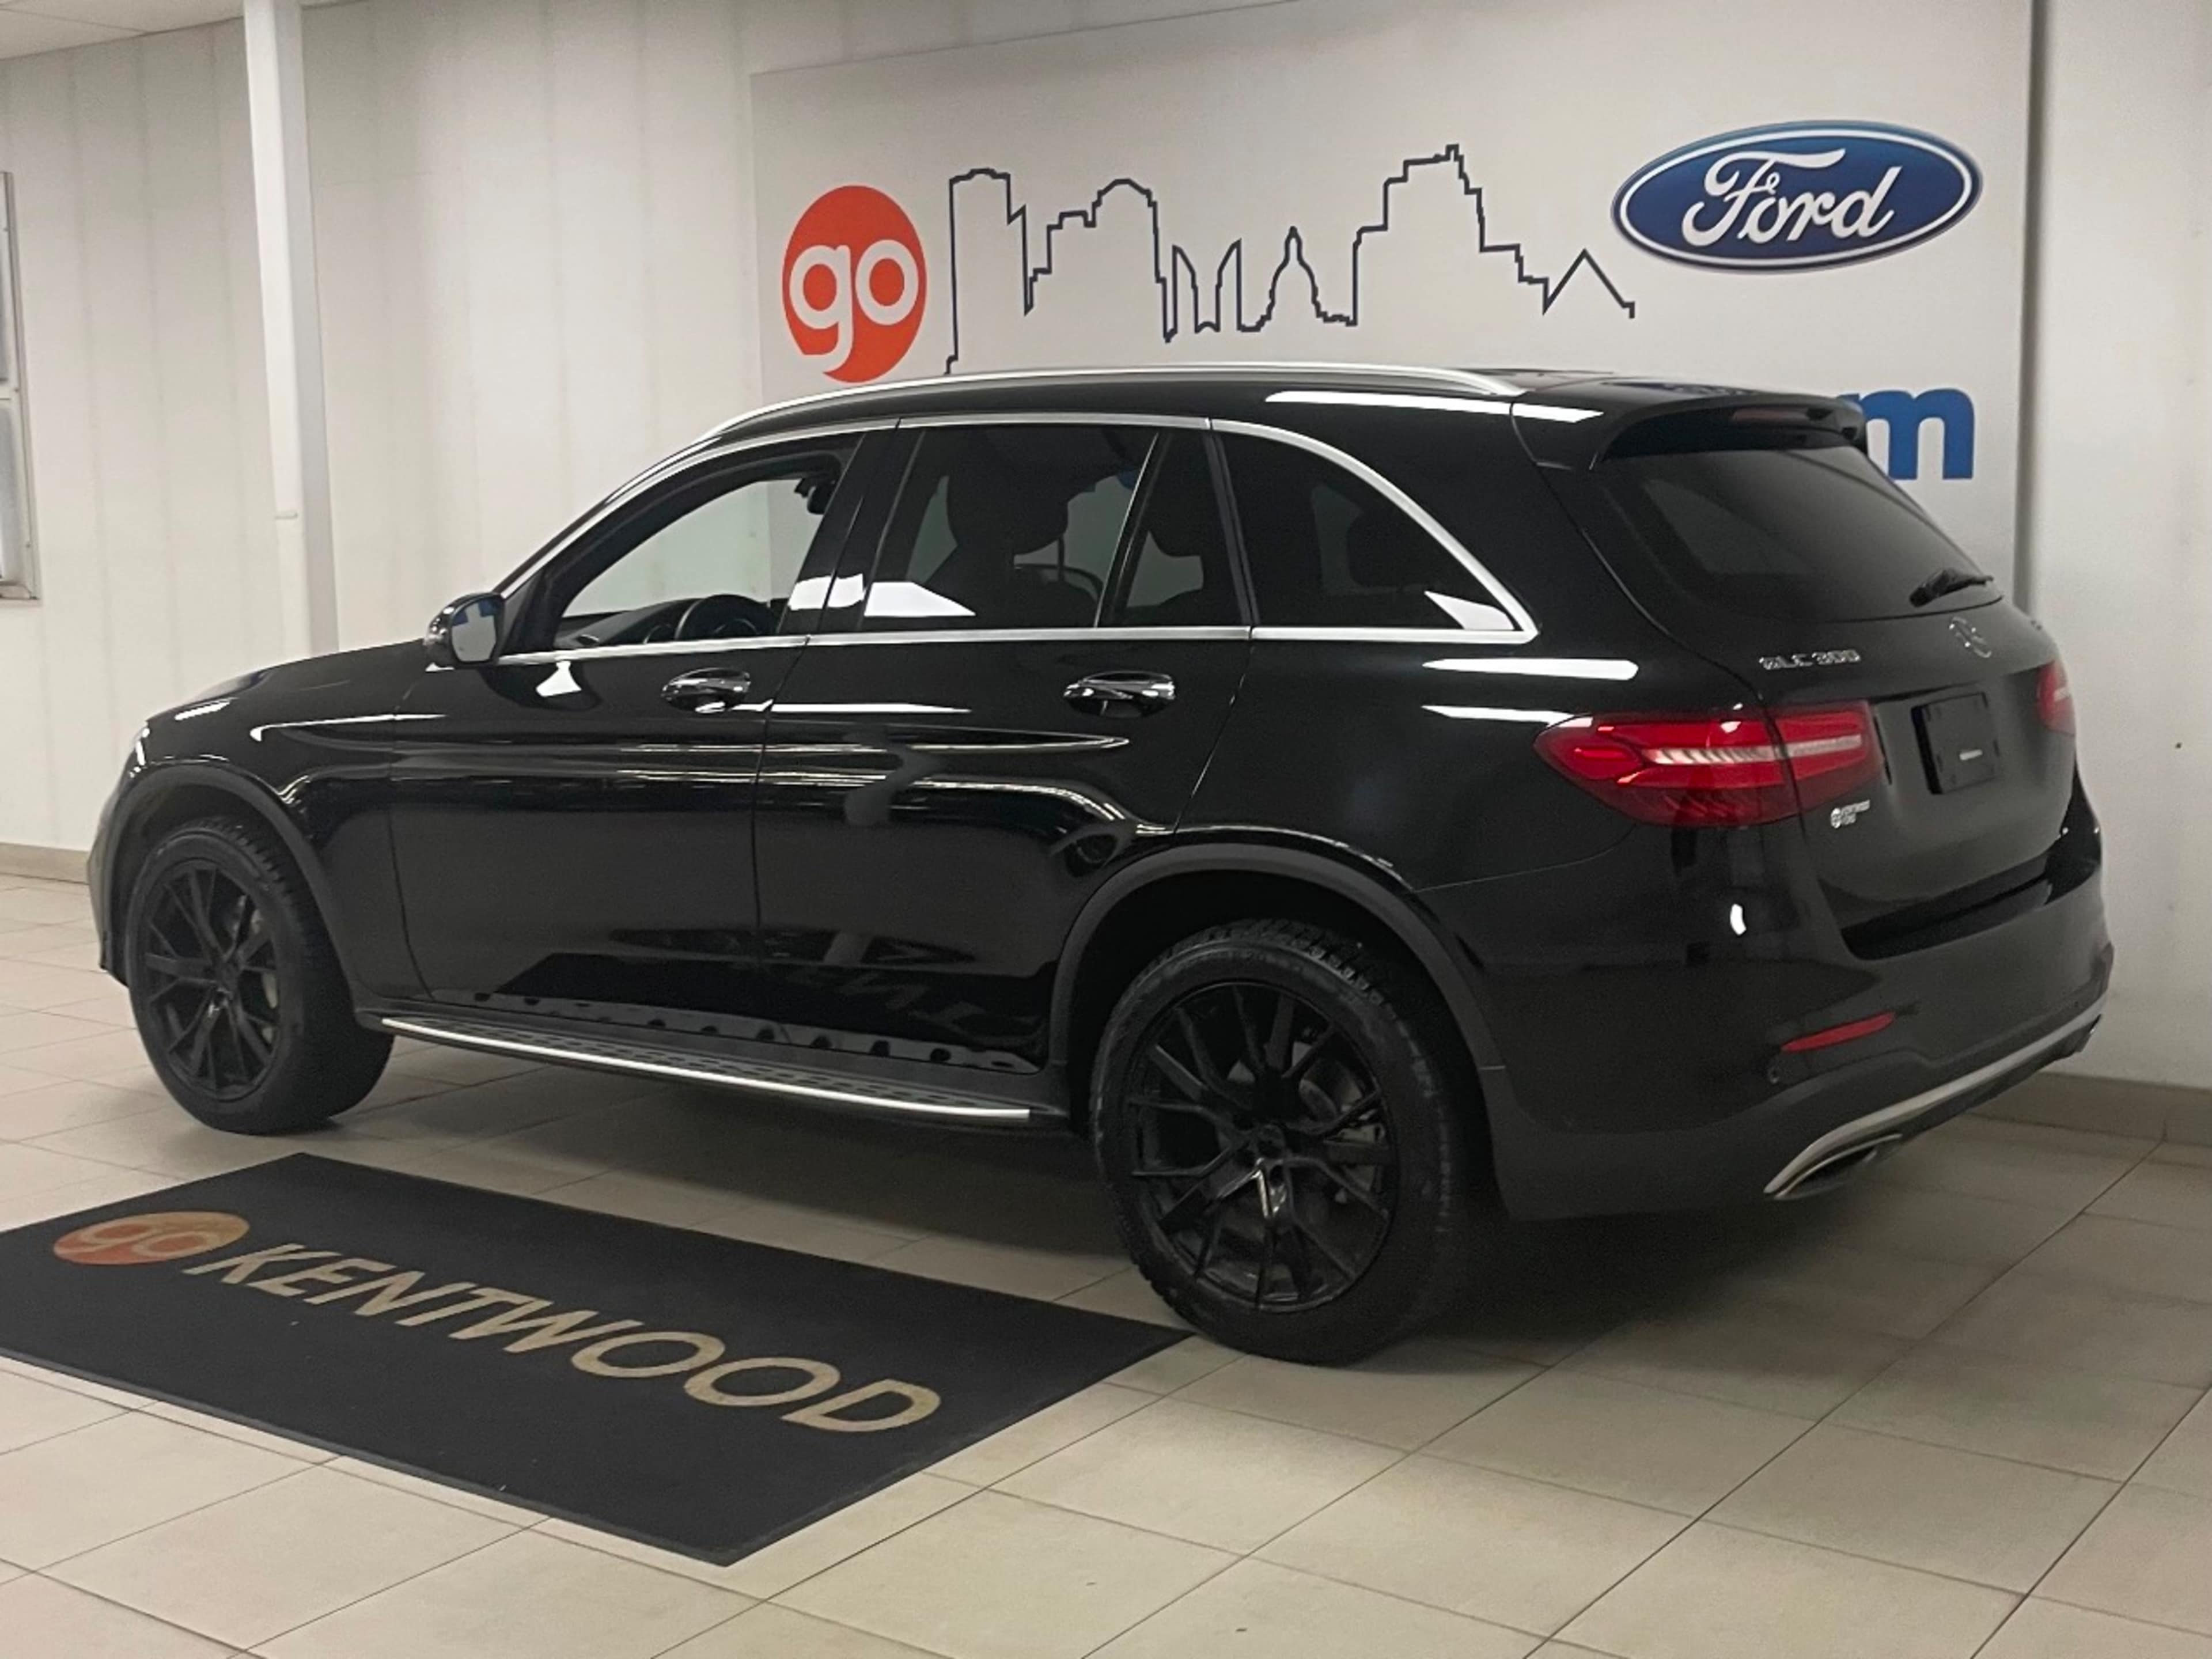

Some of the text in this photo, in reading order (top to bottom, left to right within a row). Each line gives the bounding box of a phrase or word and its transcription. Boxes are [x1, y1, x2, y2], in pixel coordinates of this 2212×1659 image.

[1681, 147, 1903, 247] Ford
[789, 238, 920, 373] go
[182, 1243, 941, 1433] KENTWOOD
